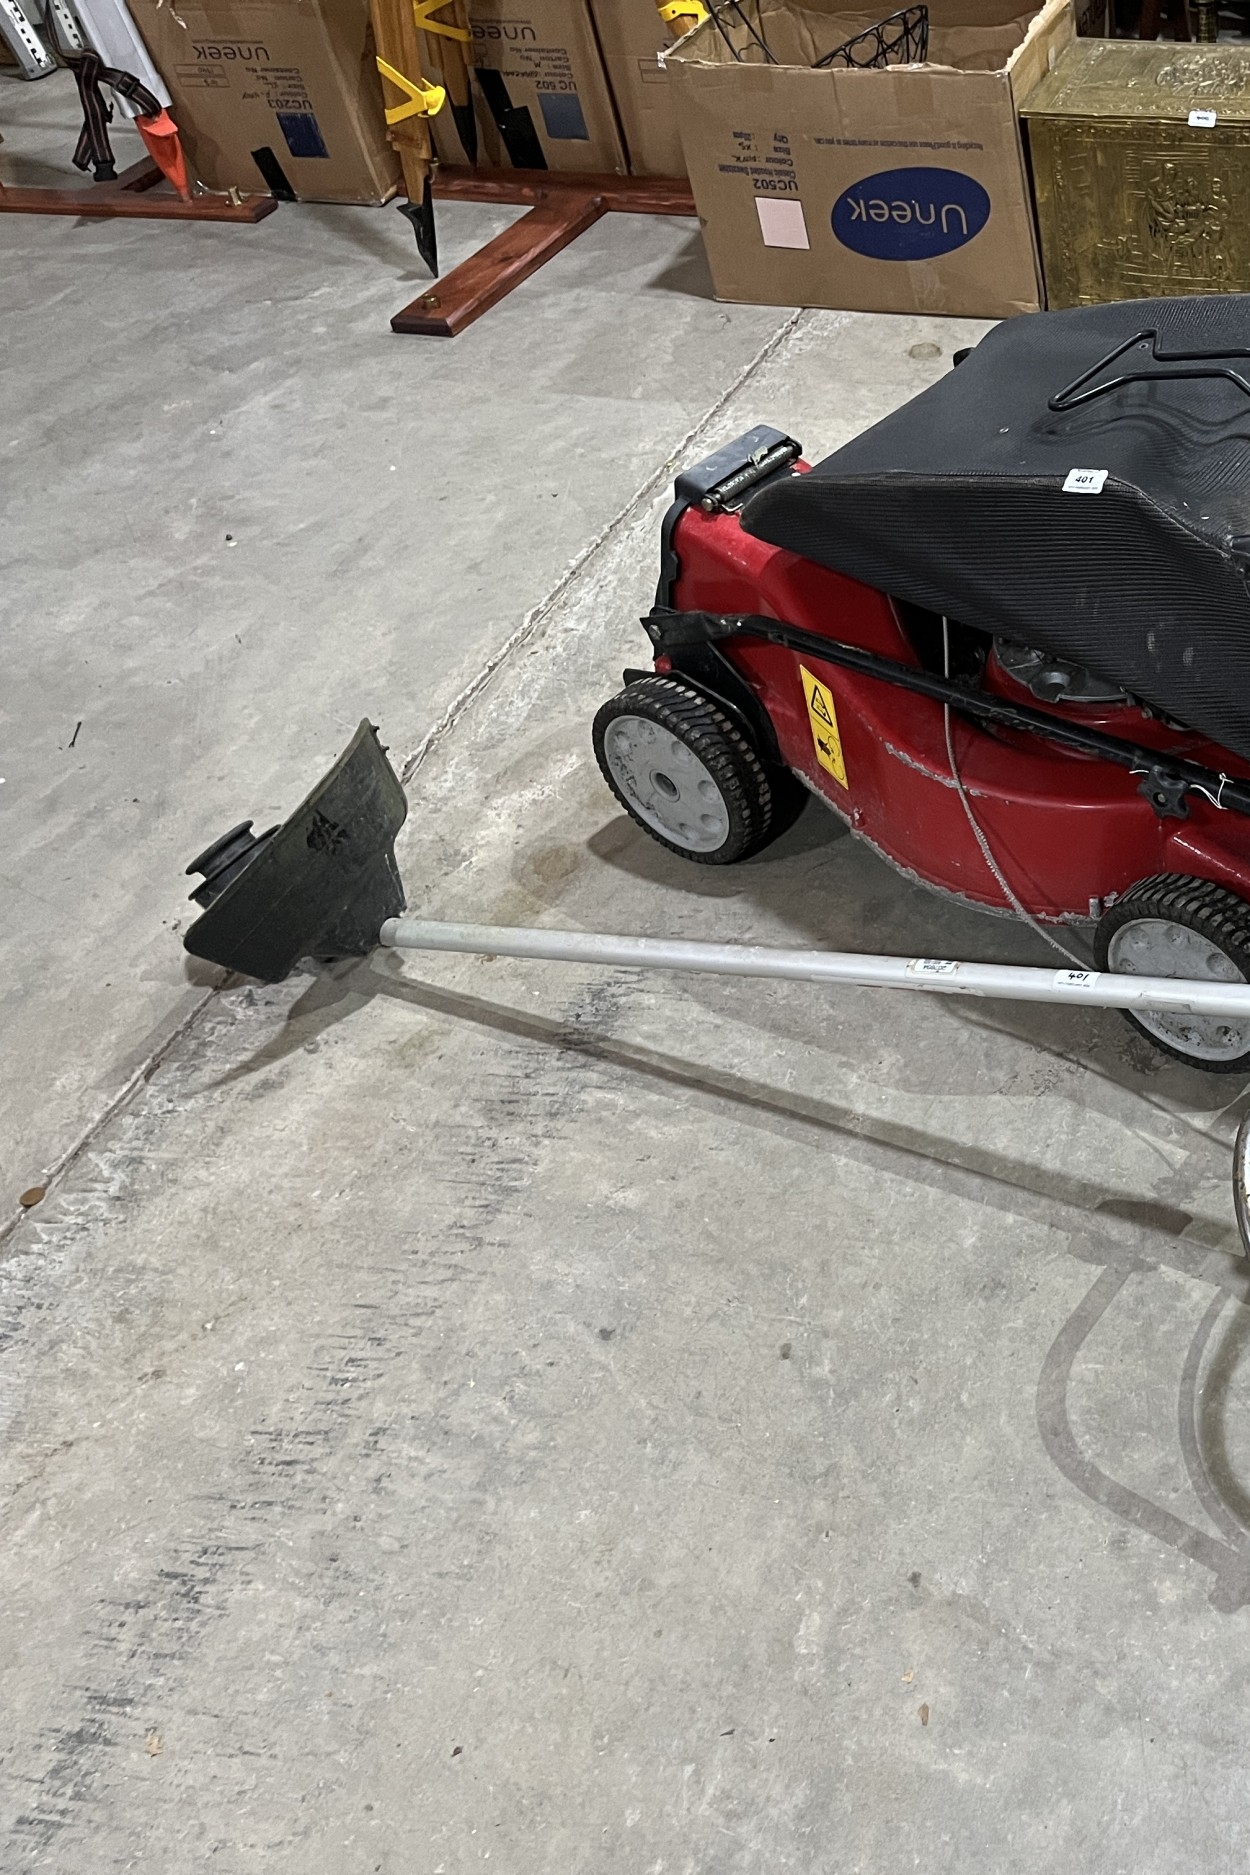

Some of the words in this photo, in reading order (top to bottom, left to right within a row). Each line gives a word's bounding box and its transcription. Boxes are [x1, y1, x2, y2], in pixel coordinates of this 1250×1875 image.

[471, 26, 536, 41] unee
[192, 46, 270, 61] uneek
[752, 179, 798, 191] UC502
[847, 197, 968, 235] Uneek
[1068, 972, 1089, 981] 401
